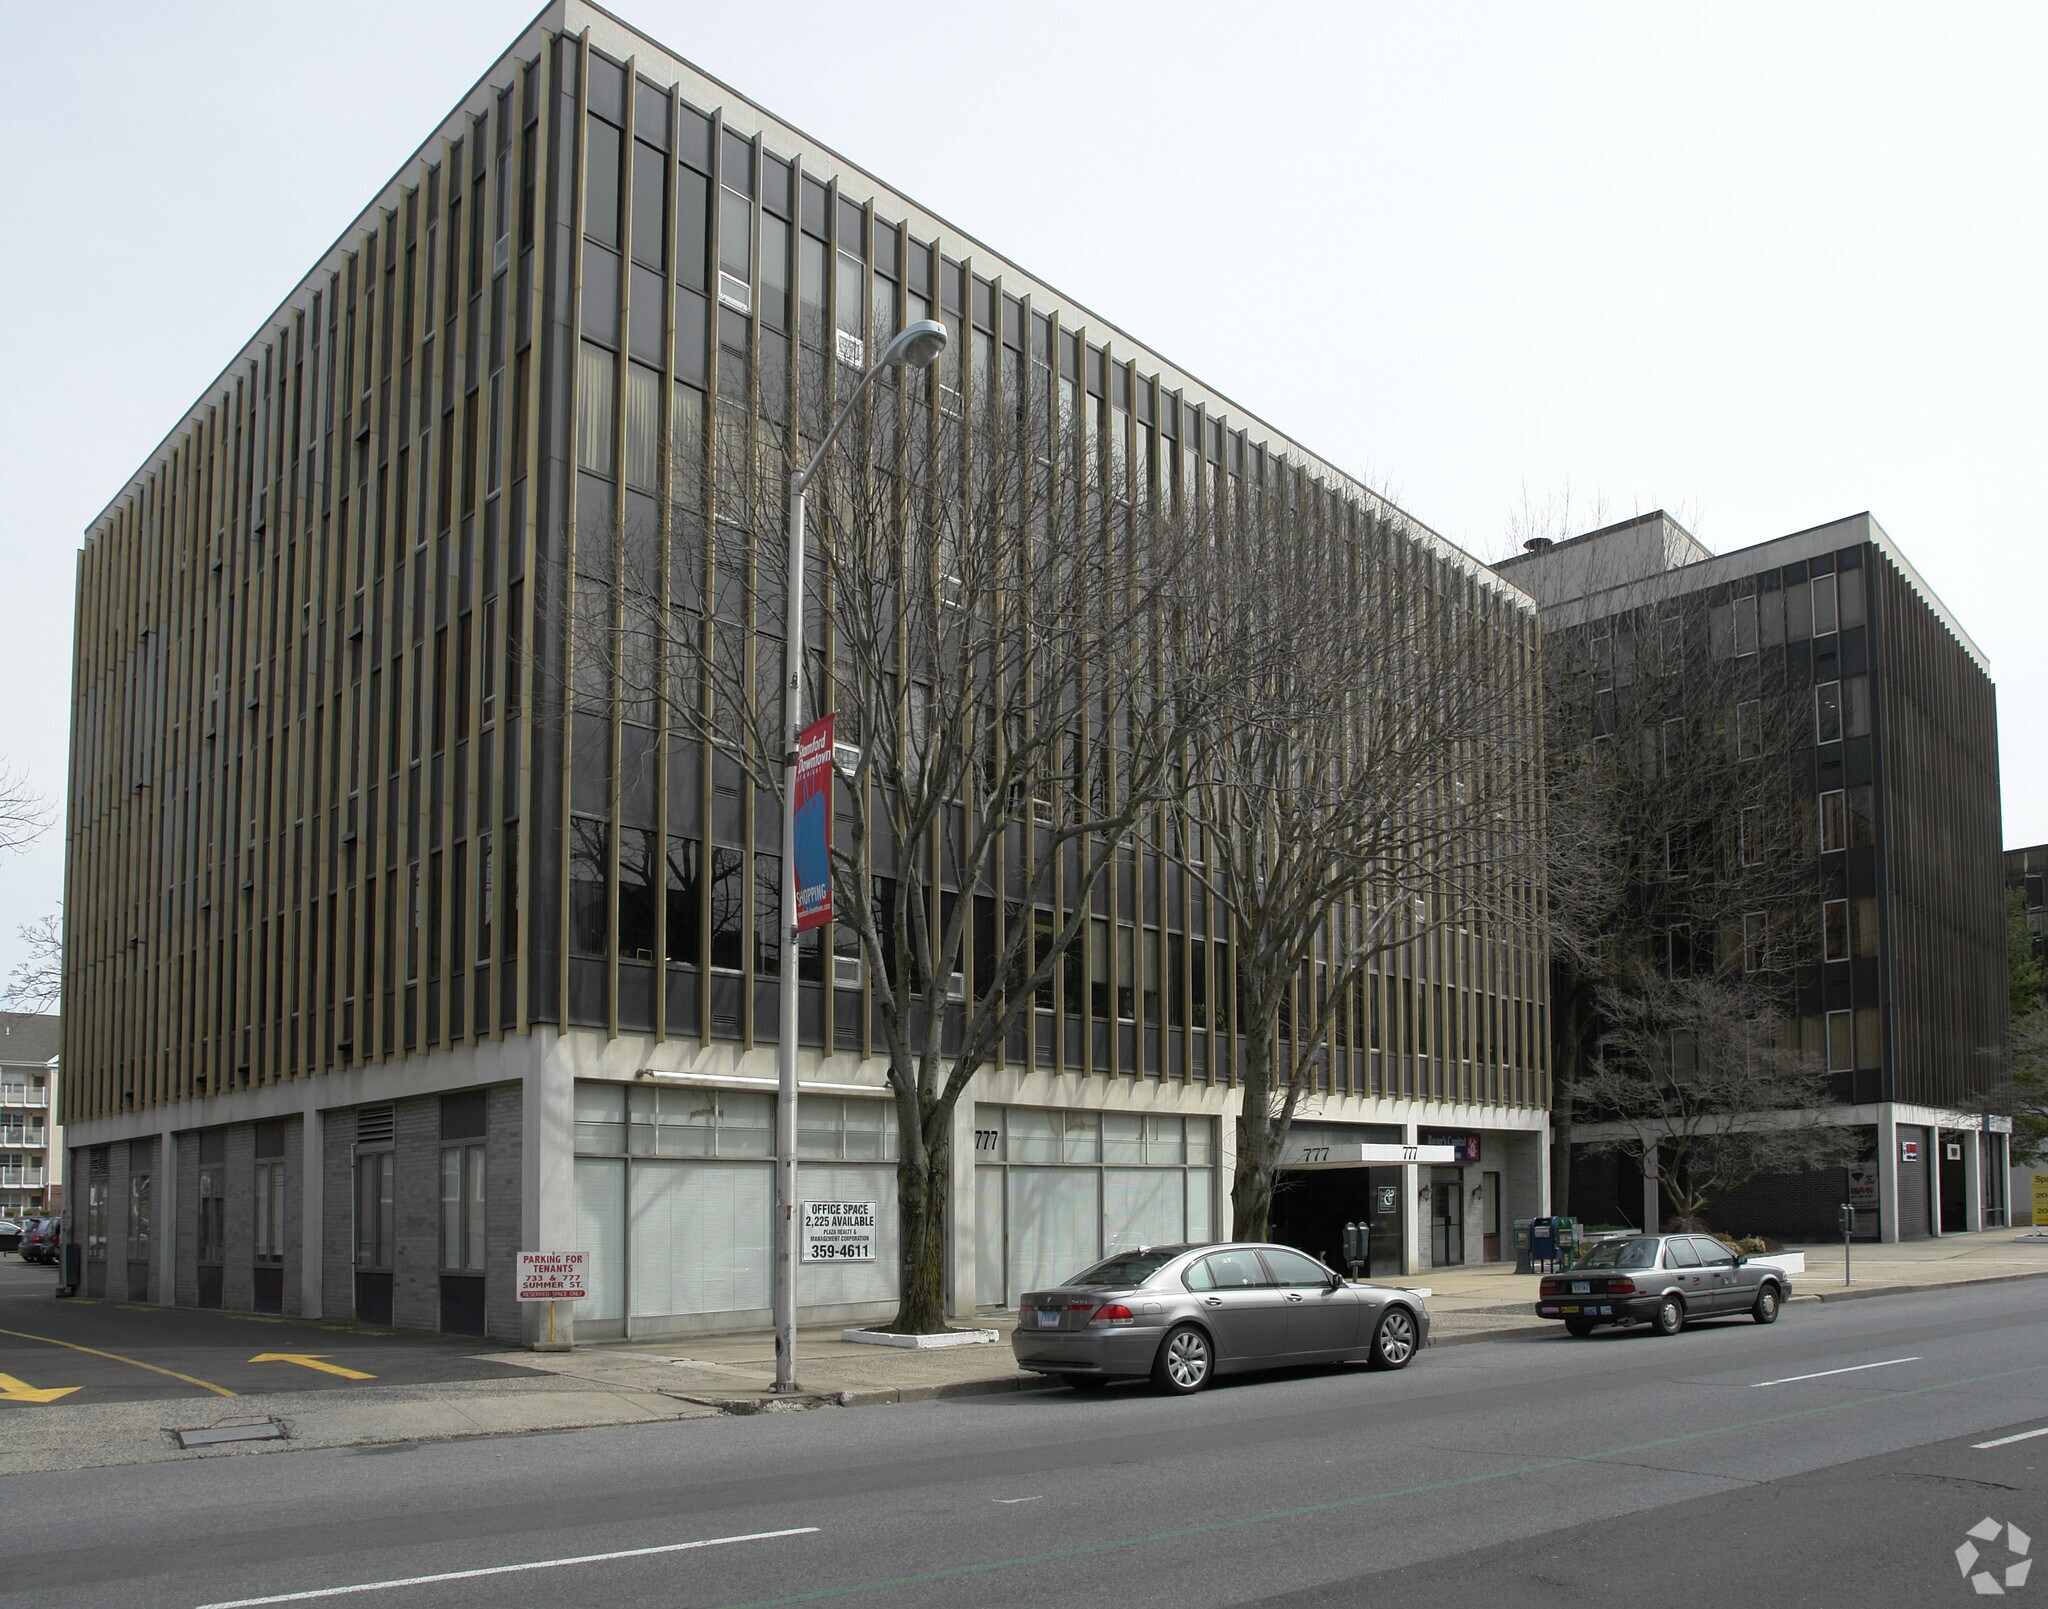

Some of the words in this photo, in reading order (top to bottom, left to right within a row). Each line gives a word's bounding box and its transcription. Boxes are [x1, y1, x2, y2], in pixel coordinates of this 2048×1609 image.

[799, 730, 826, 758] Stamford
[798, 750, 831, 774] Downtown
[797, 883, 827, 907] SHOPPING
[975, 1130, 998, 1150] 777
[1447, 1136, 1467, 1147] Capital
[1303, 1147, 1330, 1162] 777
[1402, 1146, 1418, 1160] 777
[812, 1204, 841, 1215] OFFICE
[843, 1204, 869, 1215] SPACE
[805, 1216, 830, 1228] 2,225
[832, 1216, 874, 1227] AVAILABLE
[811, 1244, 868, 1258] 359-4611
[523, 1255, 561, 1264] PARKING
[565, 1255, 583, 1263] FOR
[533, 1264, 574, 1273] TENANTS
